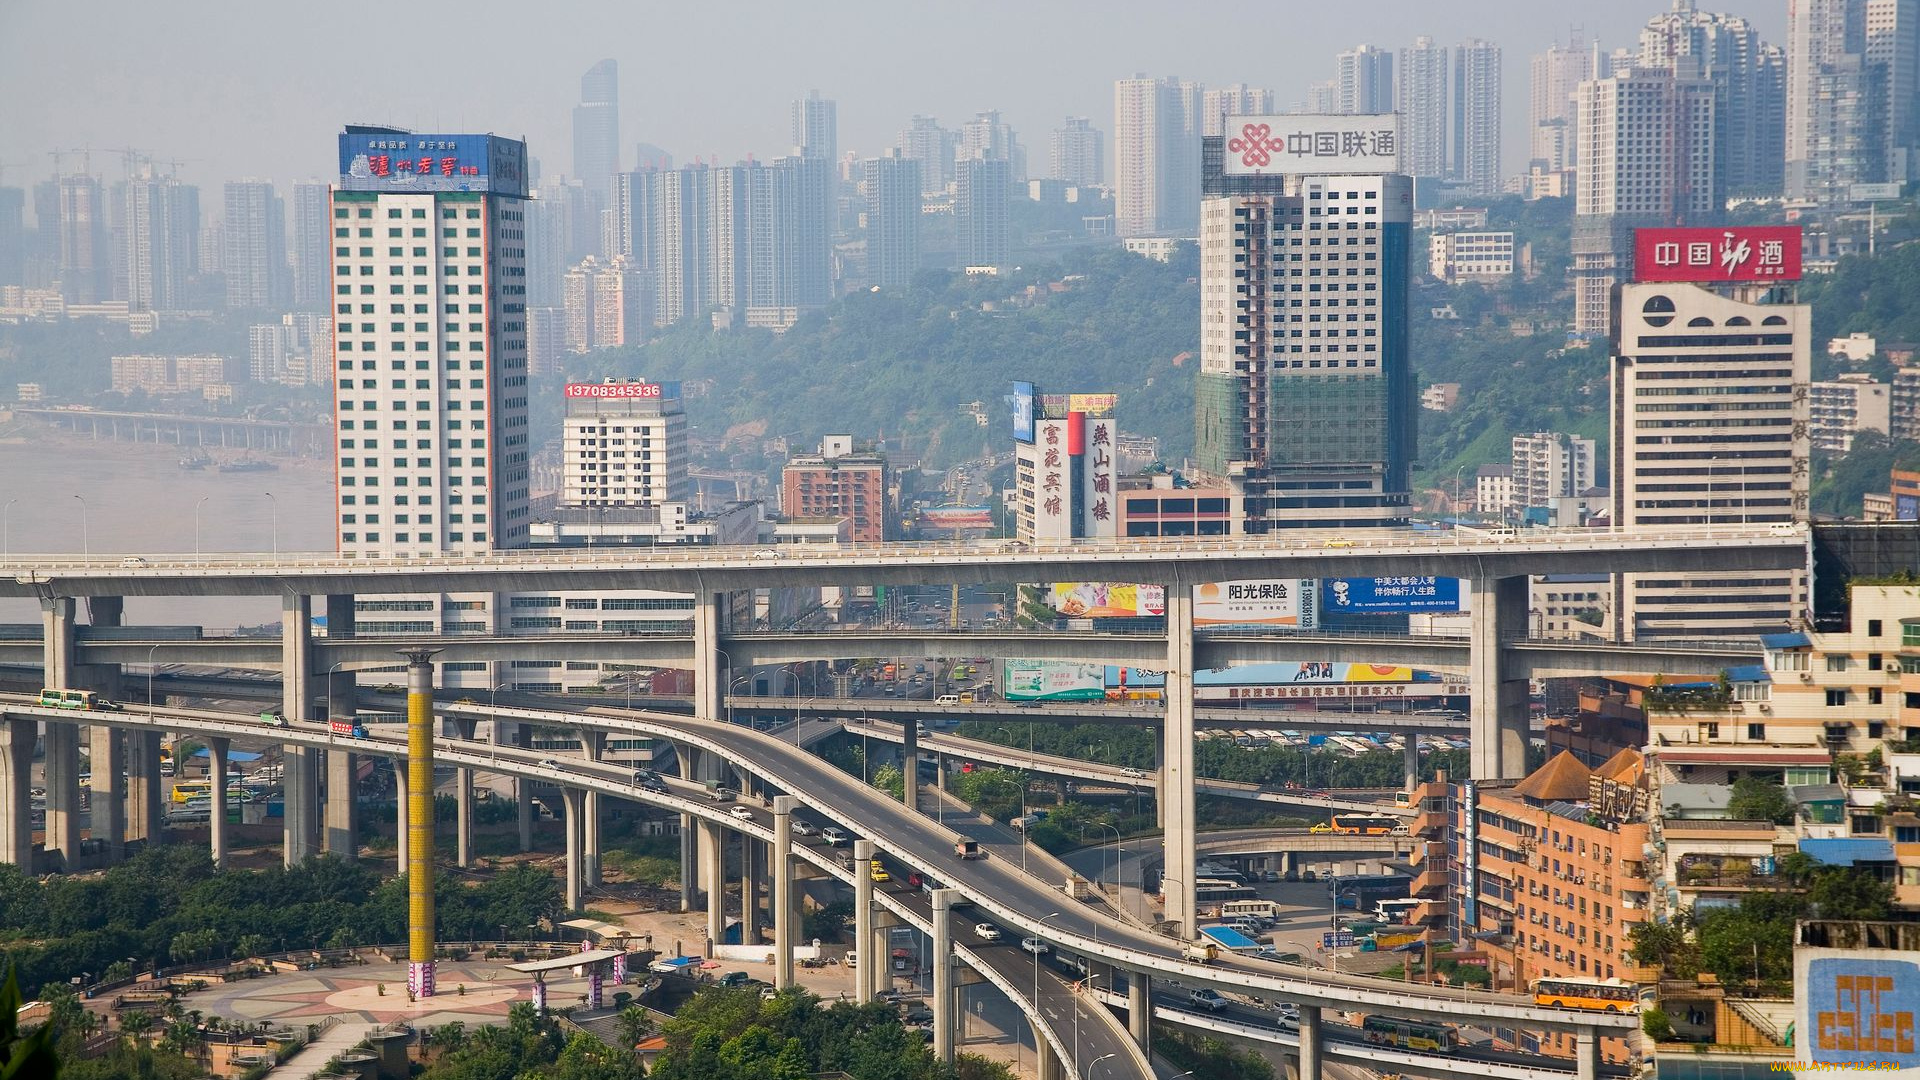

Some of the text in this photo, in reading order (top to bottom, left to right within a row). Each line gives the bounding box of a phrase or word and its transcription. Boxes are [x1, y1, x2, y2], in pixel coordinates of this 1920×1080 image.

[1287, 130, 1396, 158] 中国联通
[567, 385, 660, 397] 13708345336
[1091, 422, 1112, 522] 燕山酒楼
[1228, 584, 1288, 599] 阳光保险
[1374, 587, 1436, 597] 伴你畅行人生路
